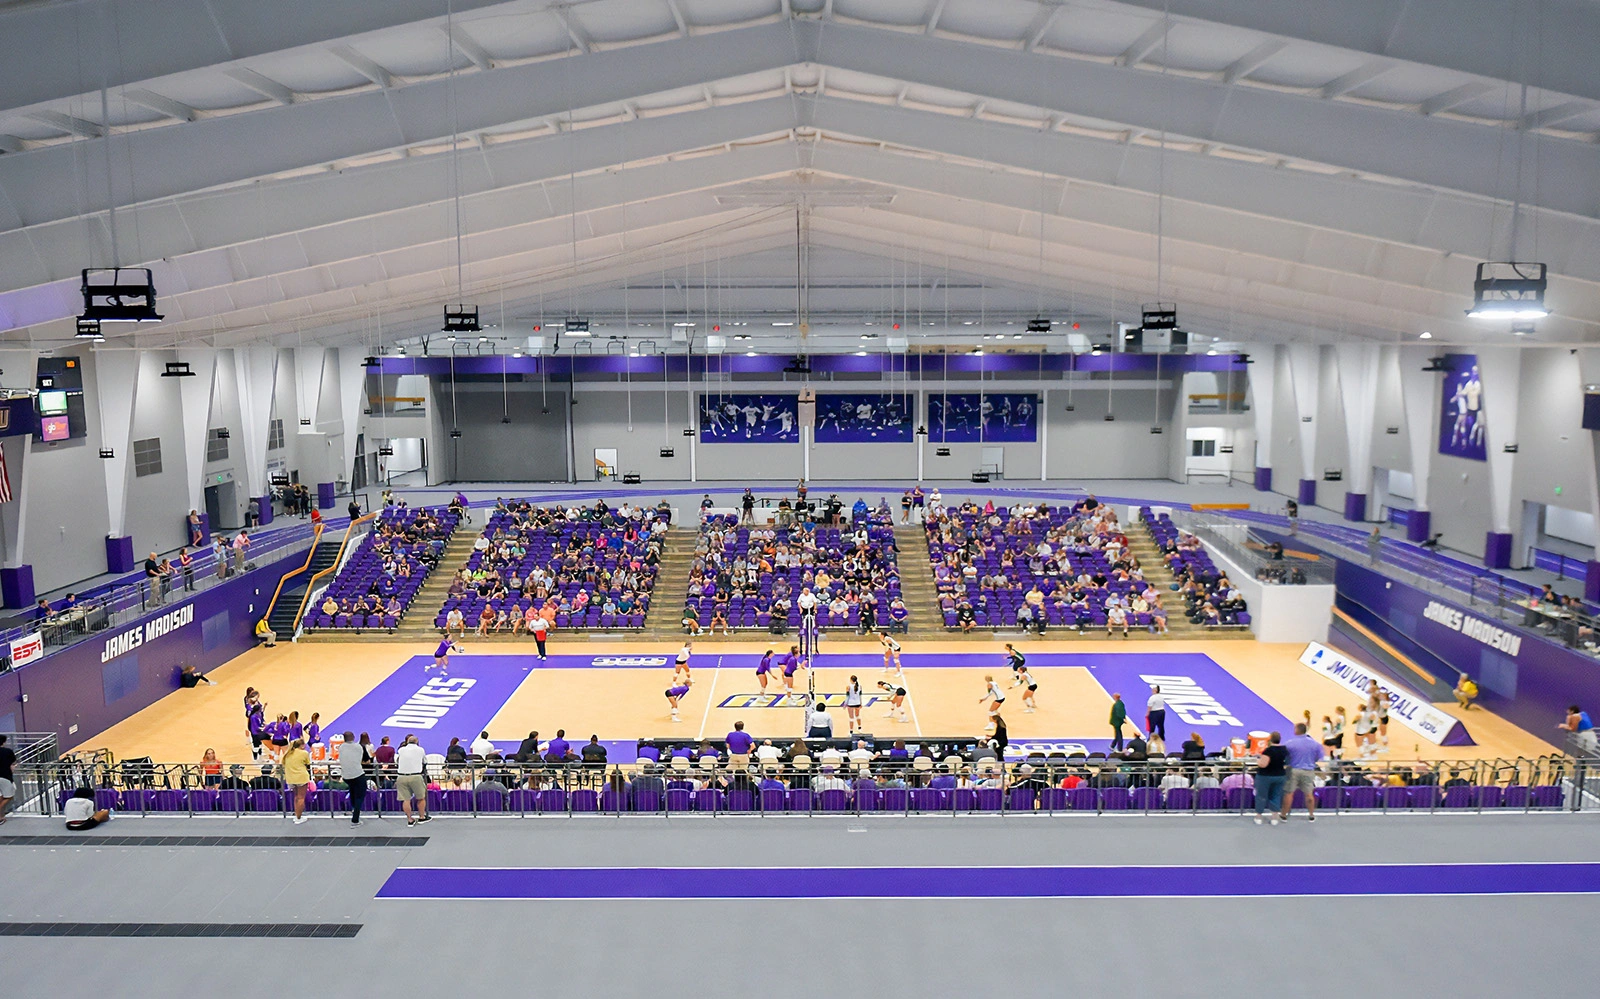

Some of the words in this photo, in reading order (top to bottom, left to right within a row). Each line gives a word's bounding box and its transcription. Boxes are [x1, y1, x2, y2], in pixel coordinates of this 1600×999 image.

[101, 625, 143, 663] JAMES
[145, 603, 194, 643] MADISON
[1423, 600, 1464, 632] JAMES
[1461, 615, 1522, 657] MADISON
[1326, 660, 1354, 679] JMU
[381, 677, 477, 730] DUKES
[1139, 674, 1244, 726] DUKES
